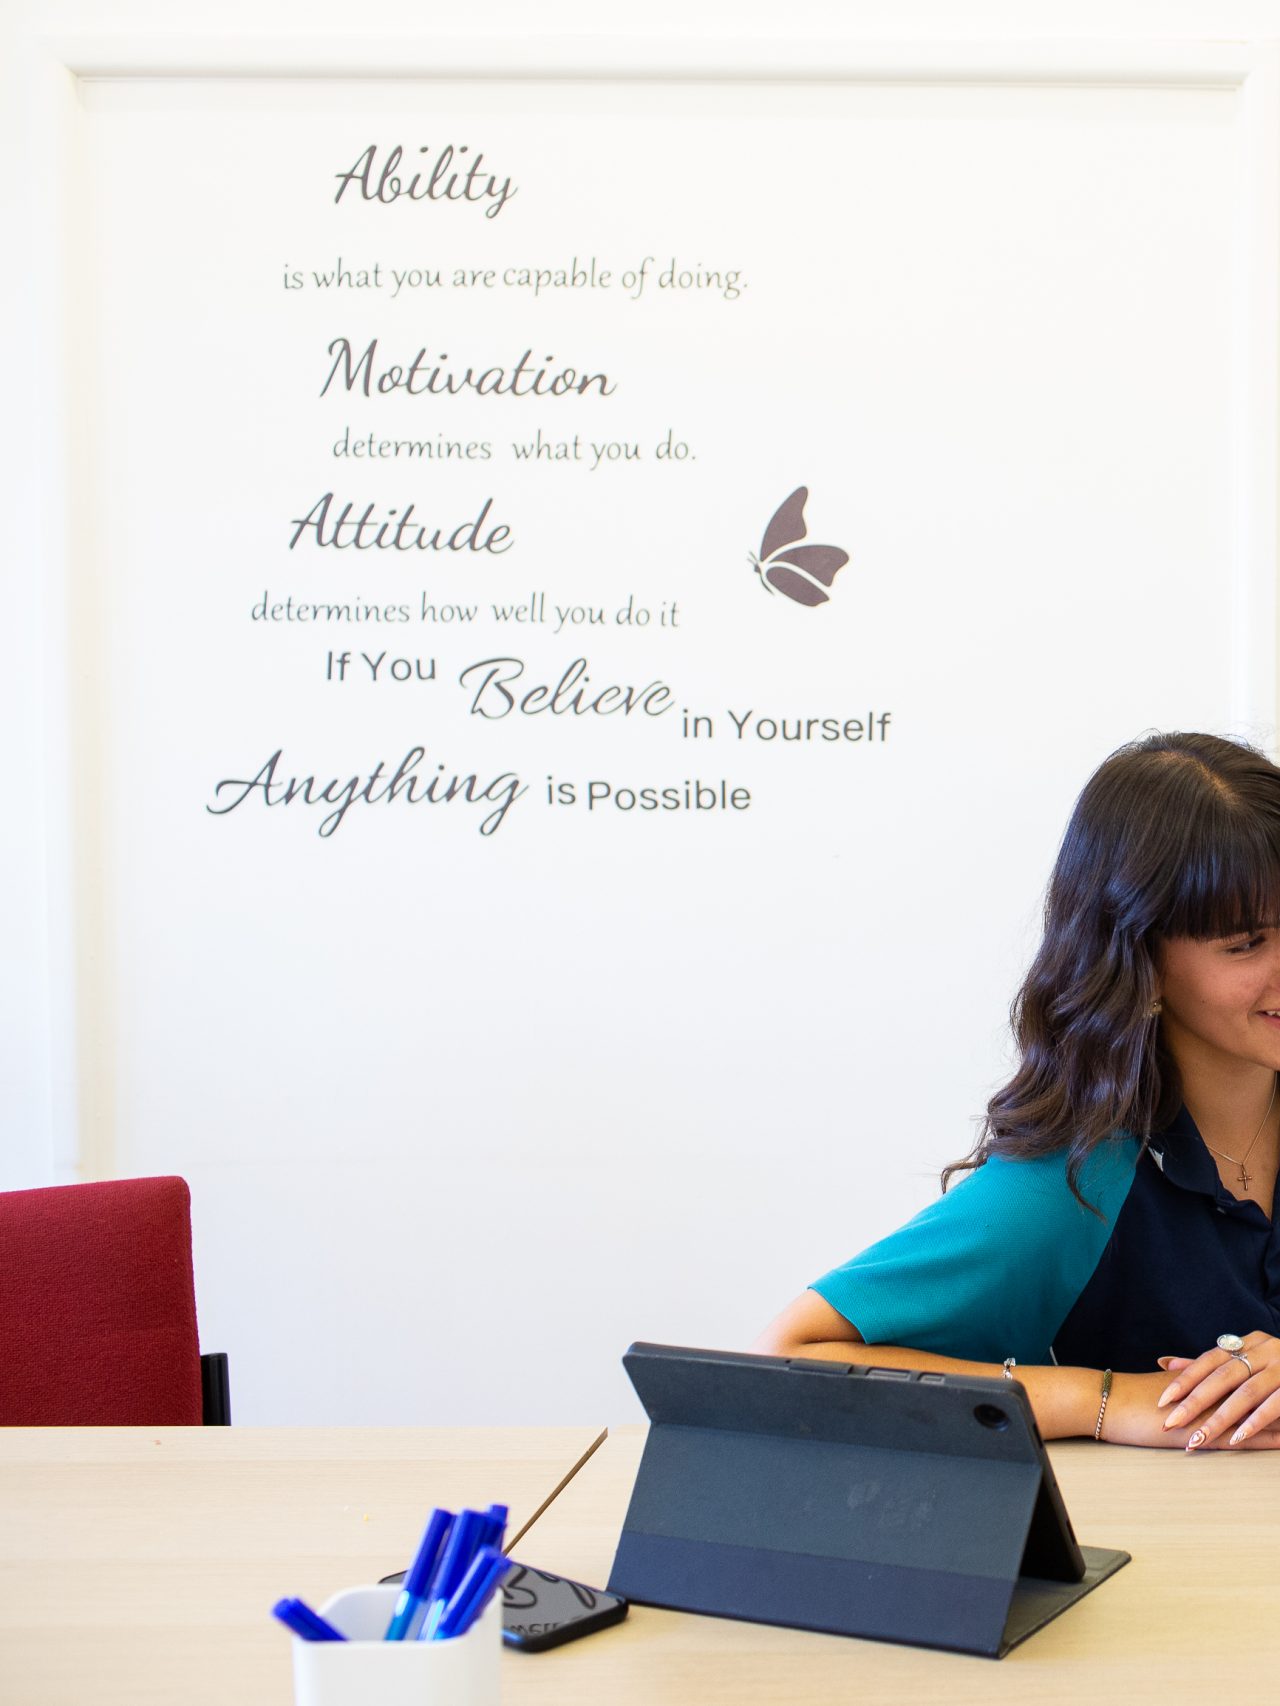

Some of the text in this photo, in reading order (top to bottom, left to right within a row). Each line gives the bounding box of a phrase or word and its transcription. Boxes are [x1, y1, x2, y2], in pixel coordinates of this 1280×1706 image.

[334, 144, 518, 219] Ability
[284, 257, 747, 299] is what you are capable of doing.
[320, 337, 617, 398] Motivation
[333, 426, 696, 471] determines what you do.
[289, 492, 514, 555] Attitude
[251, 590, 679, 634] determines how well you do it
[327, 650, 891, 742] If You Believe in Yourself
[206, 746, 751, 838] Anything is Possible
